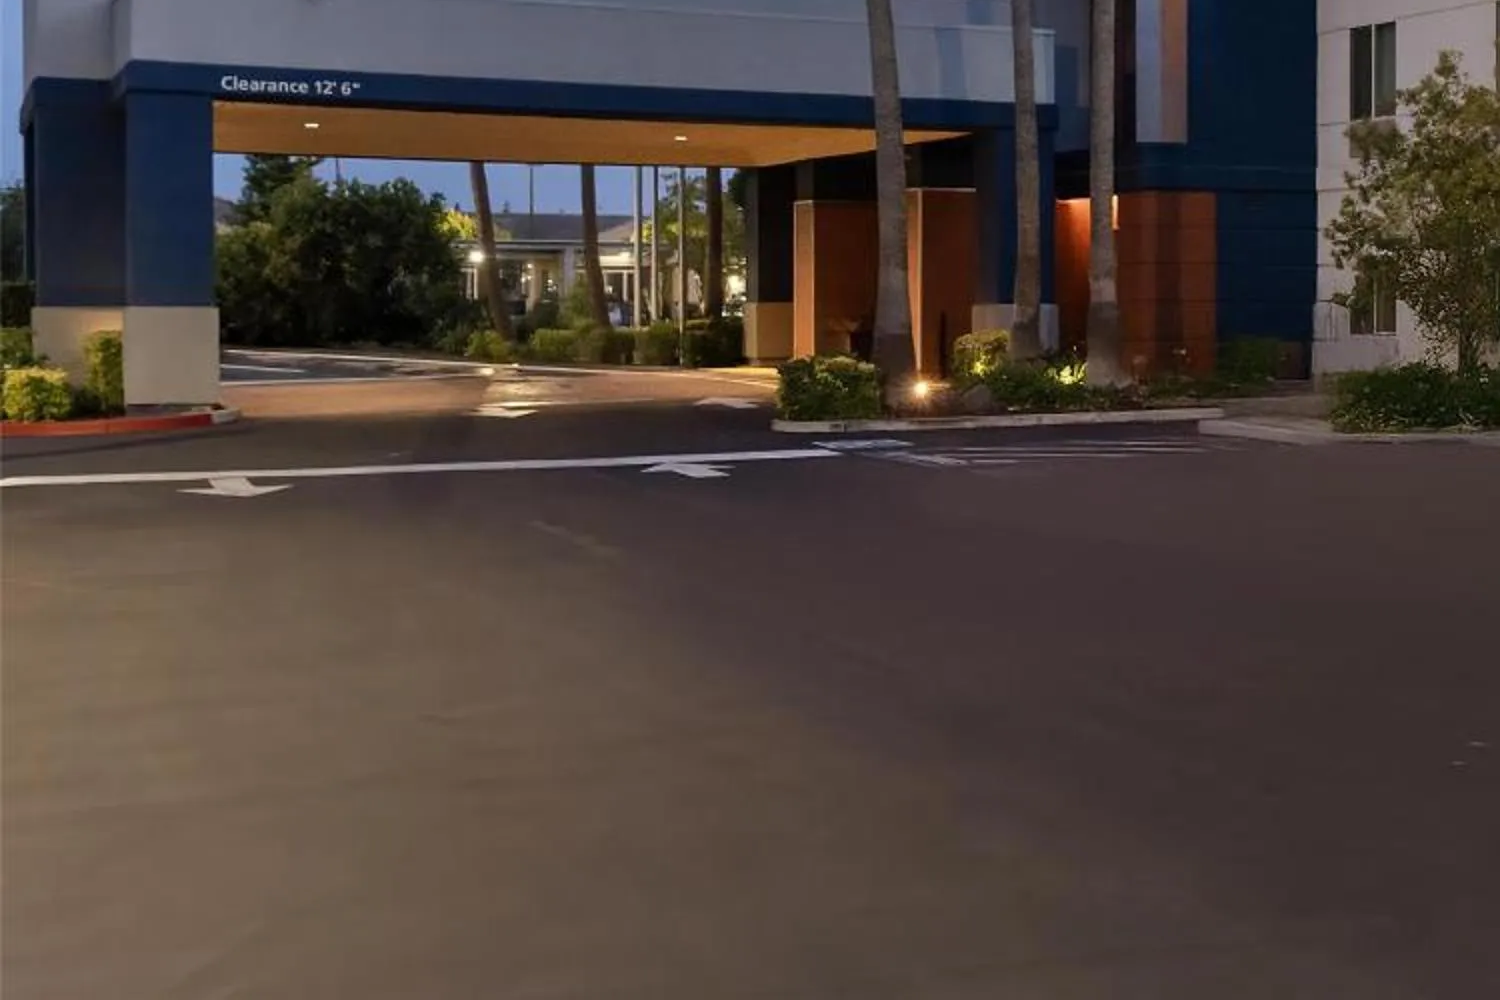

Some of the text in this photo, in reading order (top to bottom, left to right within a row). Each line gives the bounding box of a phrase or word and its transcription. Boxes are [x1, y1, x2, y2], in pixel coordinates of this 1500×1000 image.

[221, 76, 360, 95] Clearance 12' 6"
